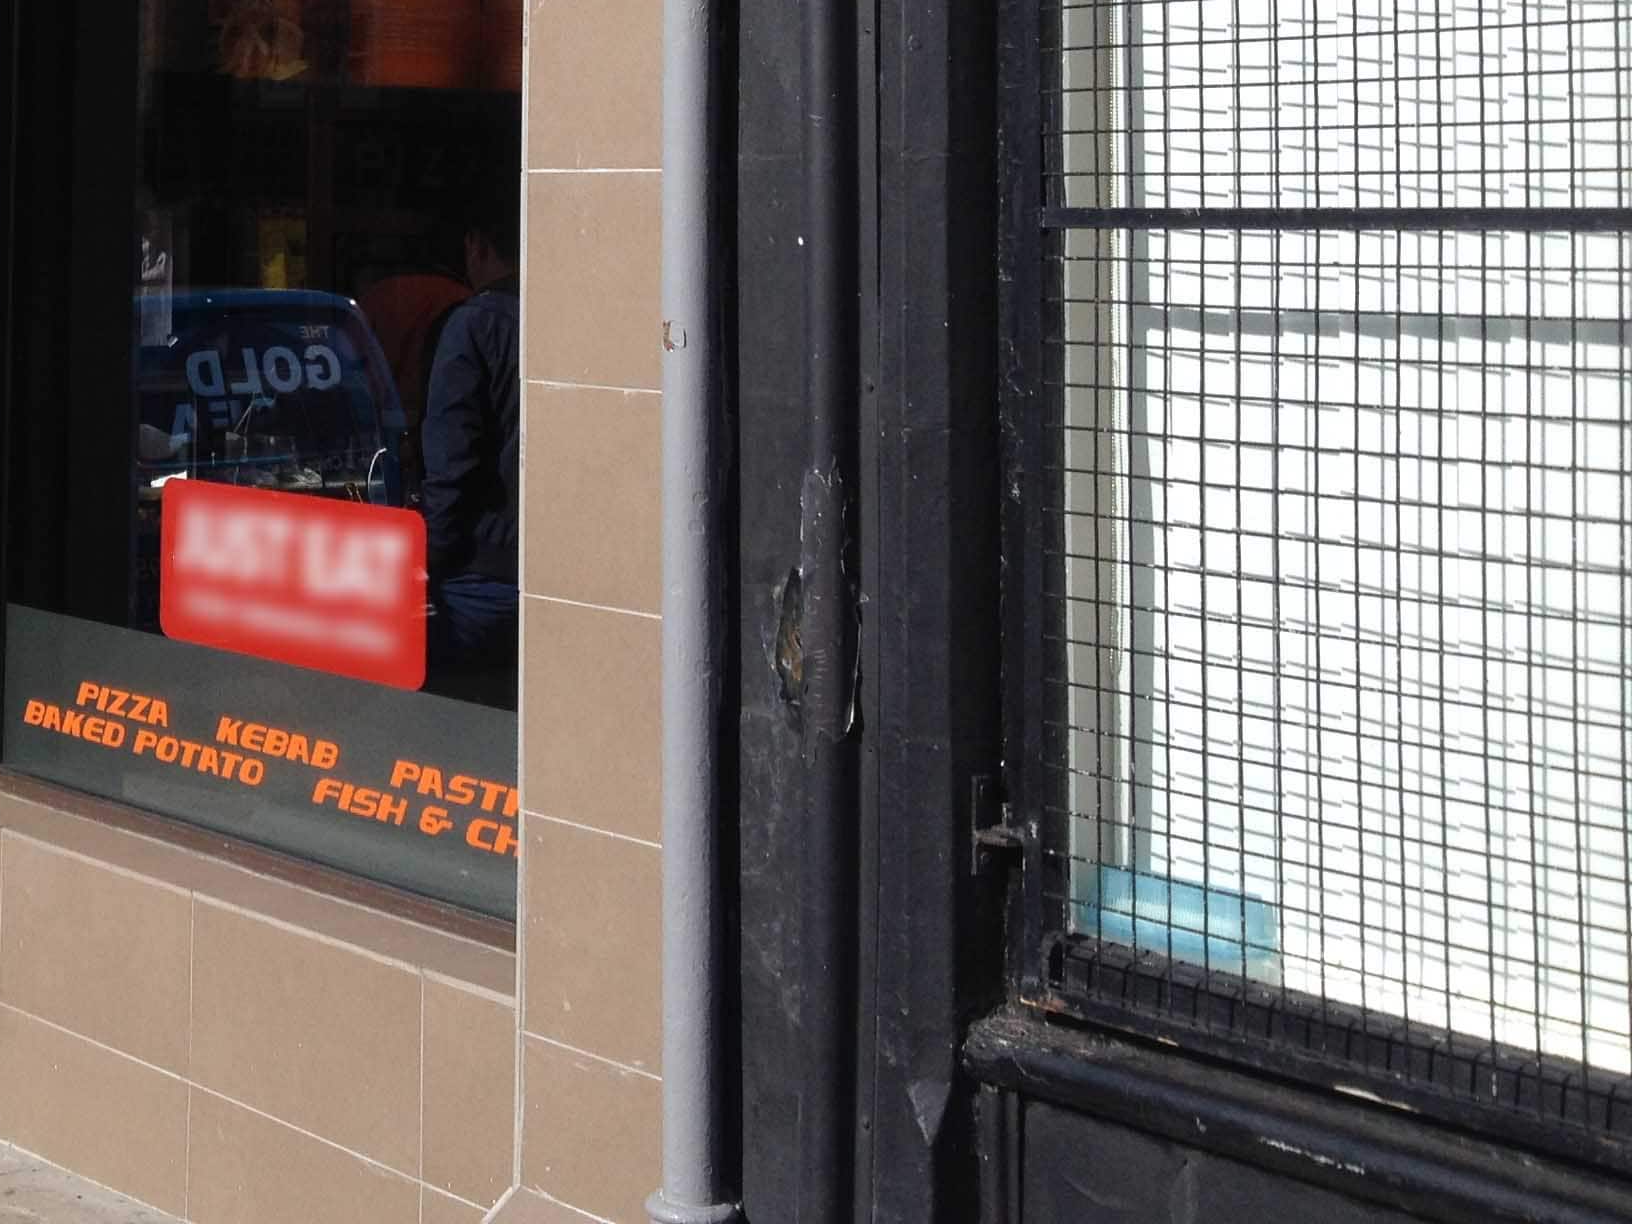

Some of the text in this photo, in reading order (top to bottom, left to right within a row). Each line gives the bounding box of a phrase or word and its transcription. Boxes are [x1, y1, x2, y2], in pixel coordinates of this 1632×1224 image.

[23, 699, 125, 749] BAKED
[134, 727, 265, 787] POTATO
[312, 776, 406, 826] FISH
[419, 805, 454, 836] &
[75, 680, 169, 728] PIZZA
[216, 715, 339, 769] KEBAB
